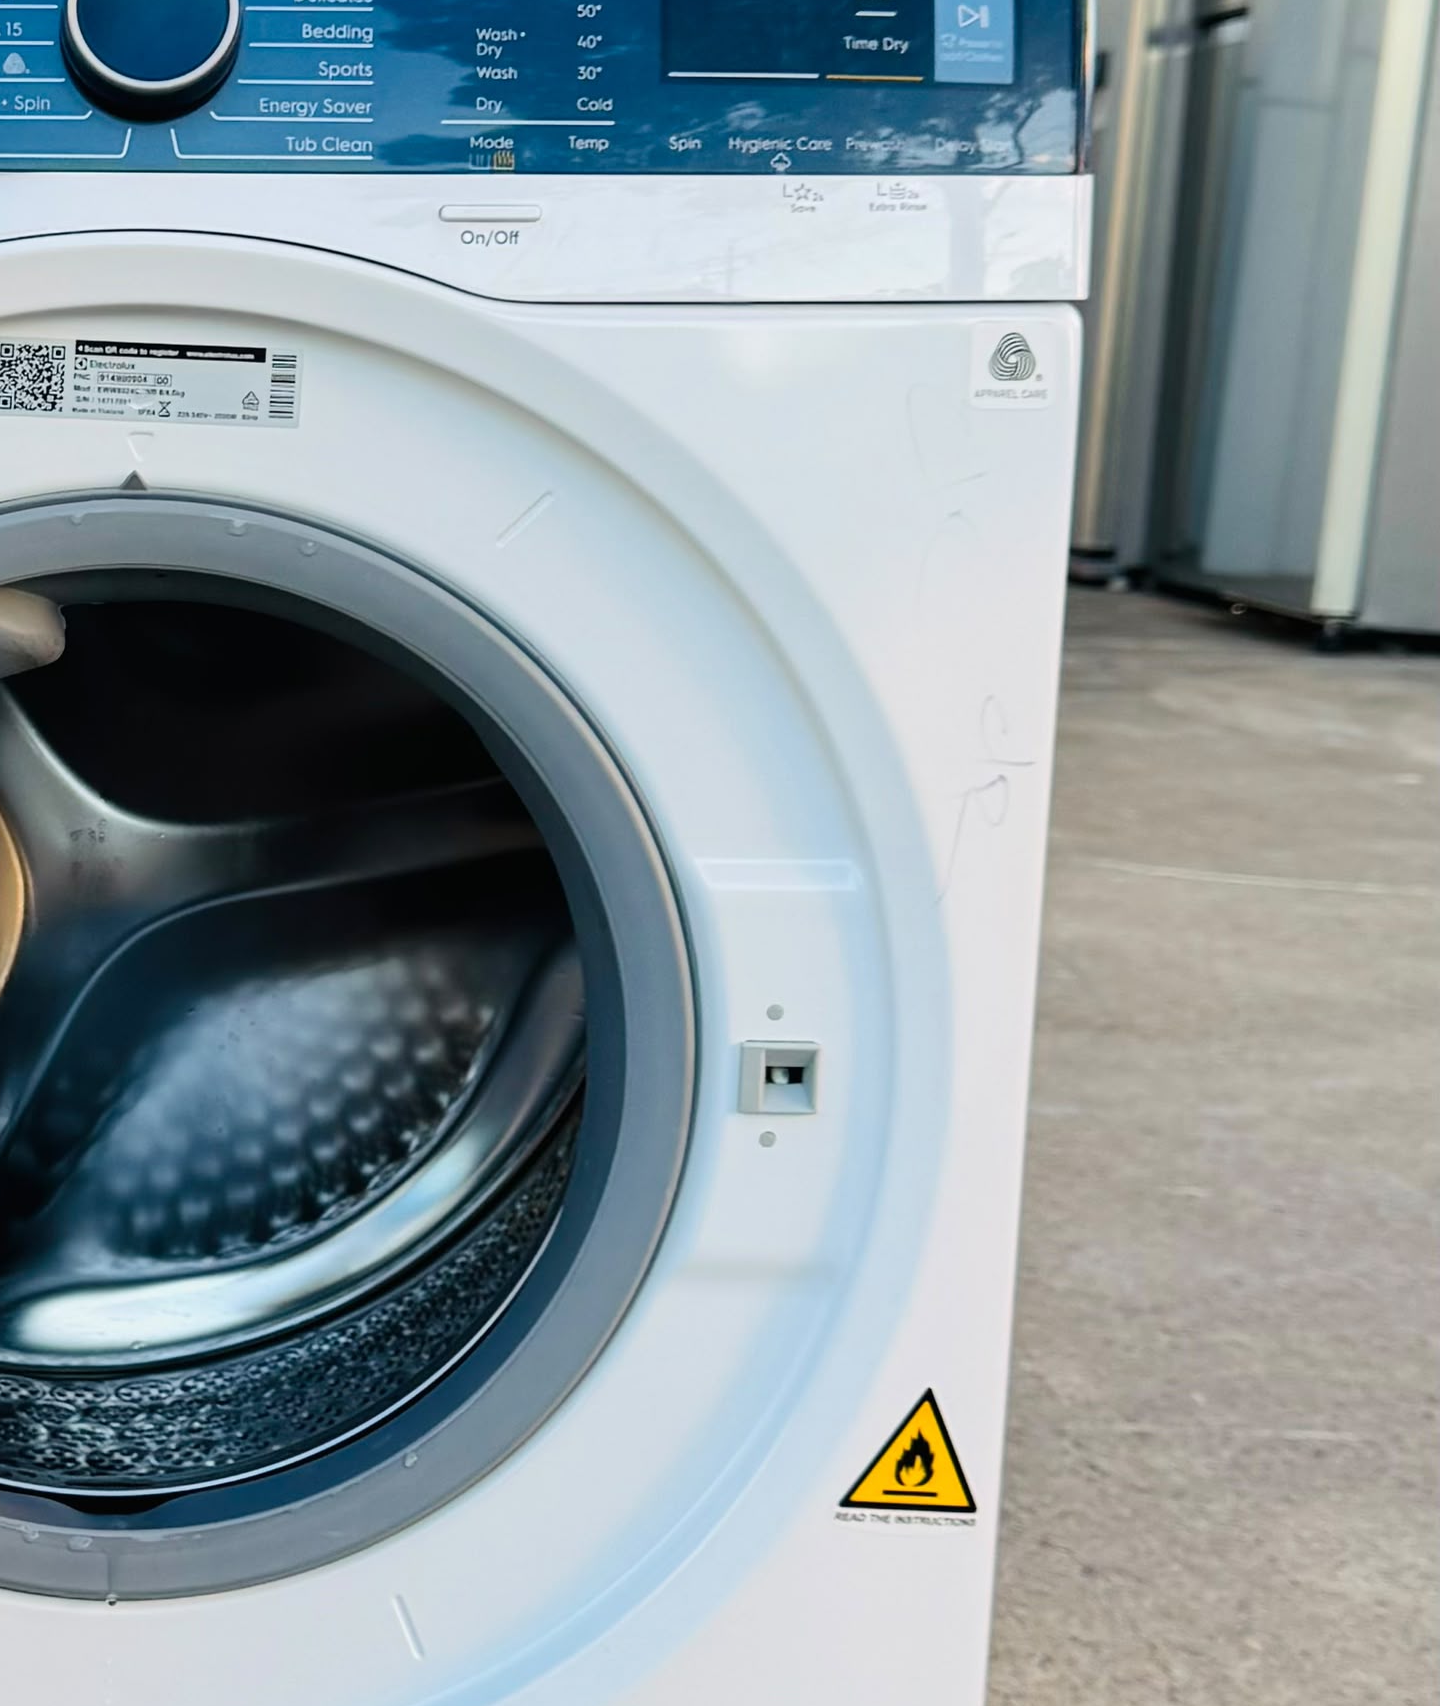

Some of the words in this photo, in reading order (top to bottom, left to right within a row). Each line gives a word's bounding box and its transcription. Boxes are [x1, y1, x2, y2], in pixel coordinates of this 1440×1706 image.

[6, 22, 22, 37] 15
[301, 24, 374, 43] Bedding
[476, 28, 518, 41] Wash
[476, 43, 503, 59] Dry
[842, 36, 878, 50] Time
[882, 37, 909, 54] Dry
[318, 62, 373, 79] Sports
[476, 66, 518, 80] Wash
[14, 95, 51, 113] Spin
[259, 99, 319, 117] Energy
[322, 99, 373, 115] Saver
[476, 97, 503, 114] Dry
[576, 97, 614, 111] Cold
[285, 137, 317, 152] Tub
[320, 137, 373, 152] Clean
[469, 136, 515, 150] Mode
[568, 135, 610, 153] Temp
[669, 136, 703, 152] Spin
[728, 136, 792, 154] Hygienic
[795, 137, 833, 151] Care
[460, 230, 520, 248] On/Off
[89, 360, 135, 370] Electrolux
